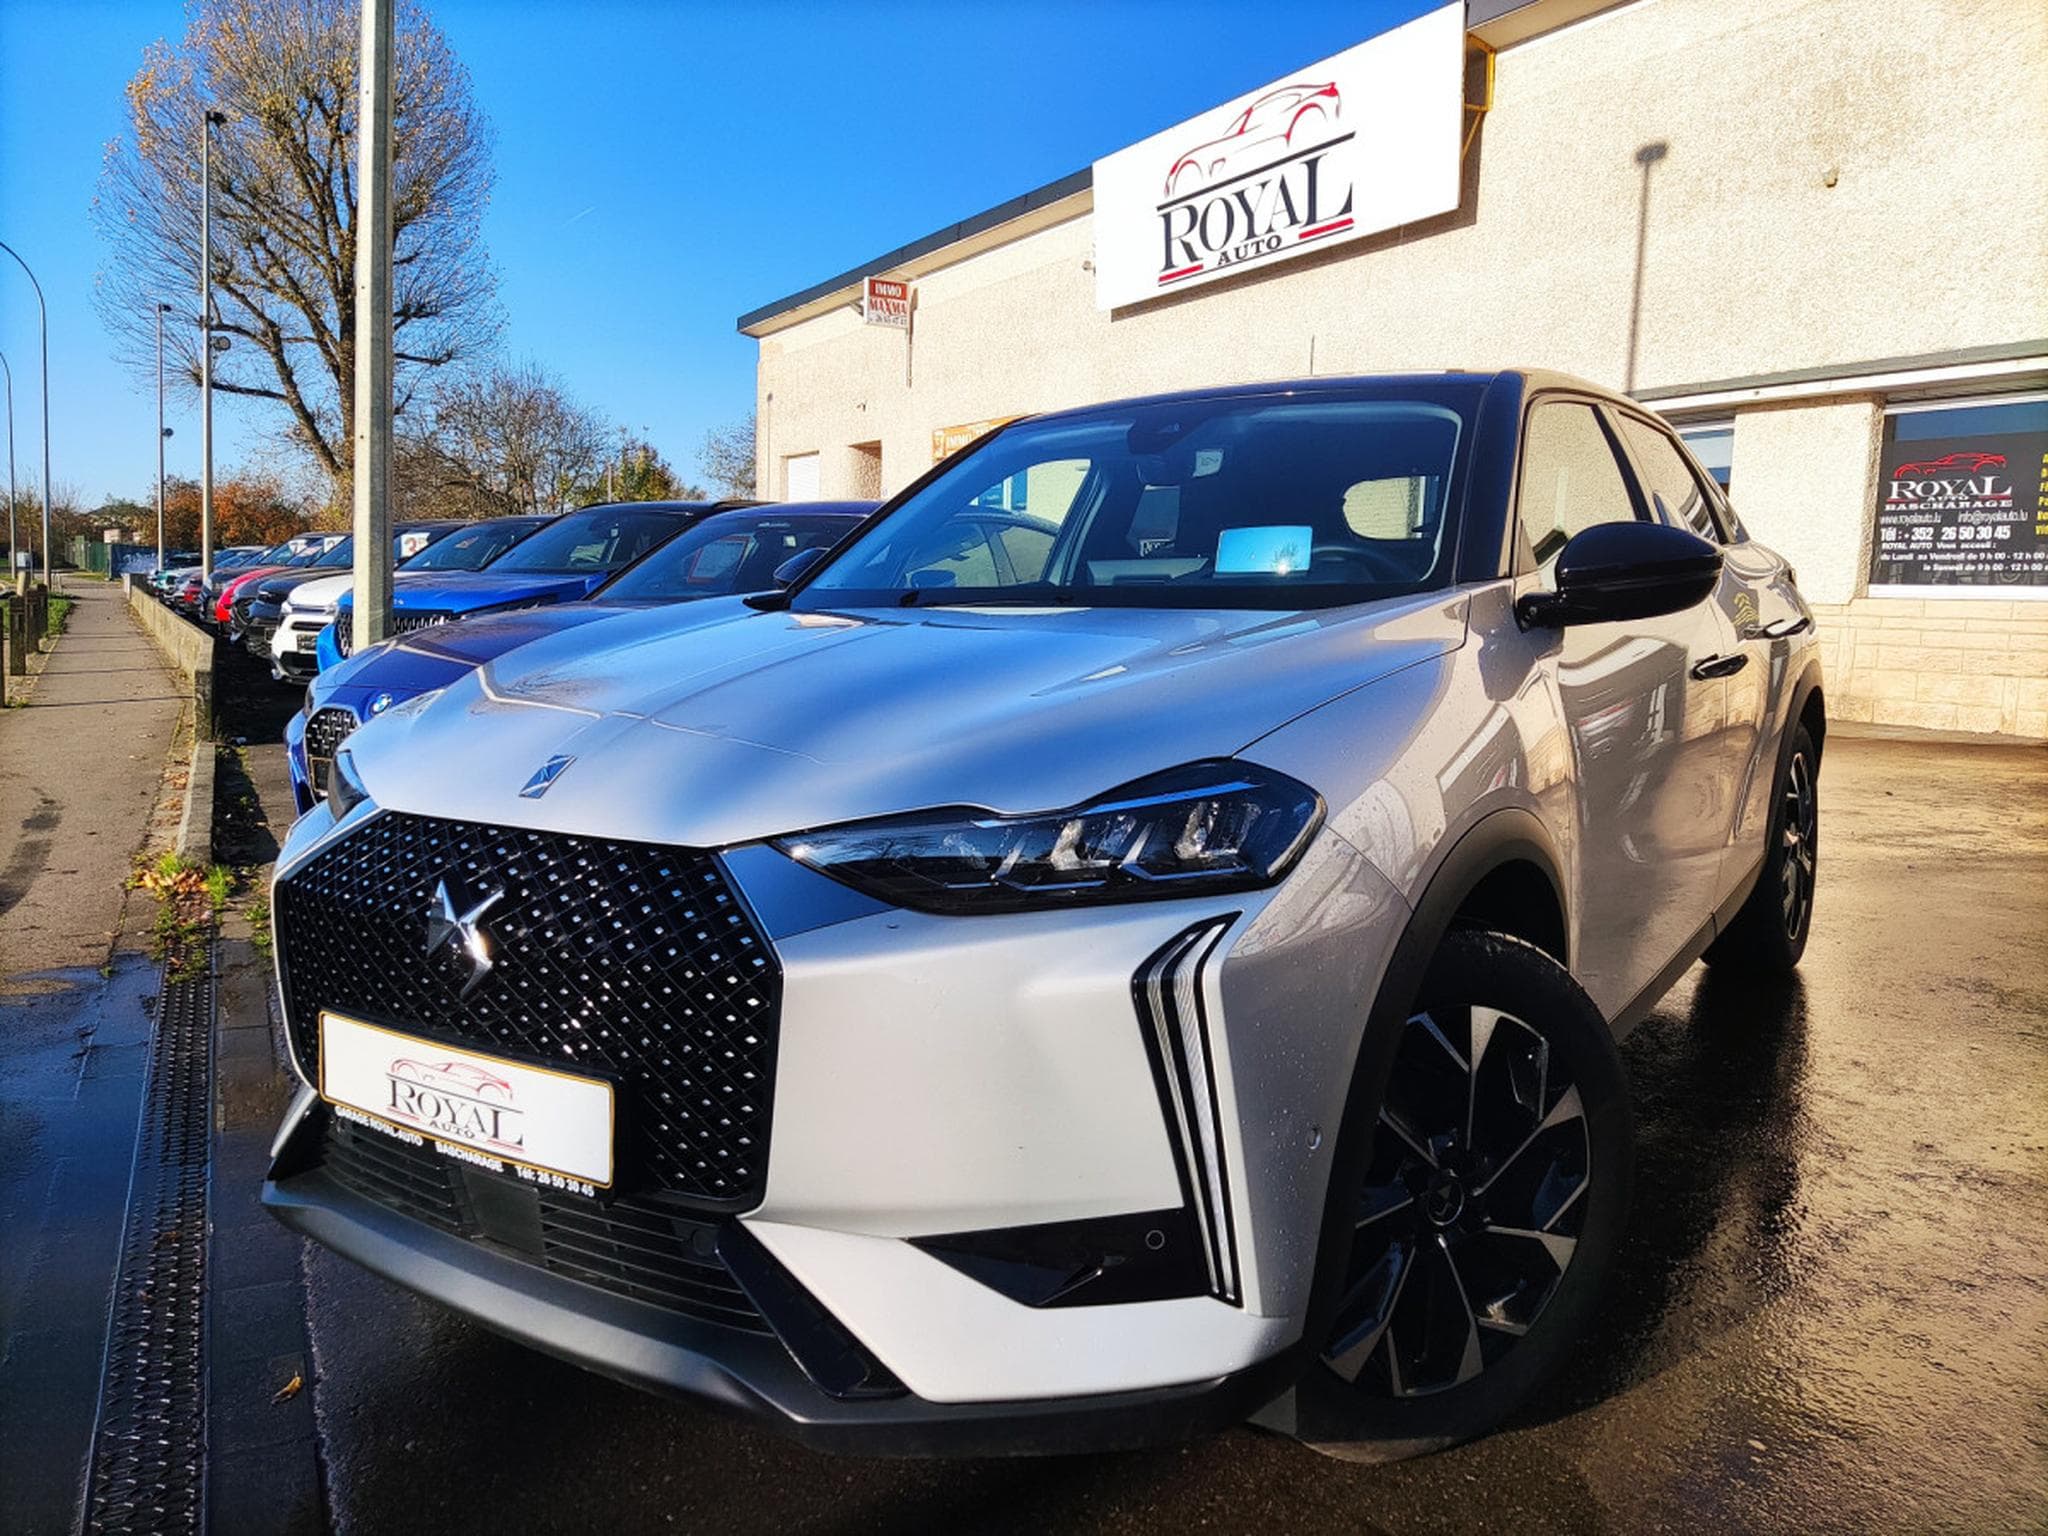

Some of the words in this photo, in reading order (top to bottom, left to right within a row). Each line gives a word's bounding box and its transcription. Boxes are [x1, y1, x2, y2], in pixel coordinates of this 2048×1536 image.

[1158, 152, 1353, 271] ROYAL
[1217, 234, 1283, 266] AUTO
[874, 282, 902, 298] IMMO
[1889, 475, 2013, 500] ROYAL
[1885, 500, 2013, 511] BASCHARAGE
[1926, 494, 1970, 503] AUTO
[1911, 526, 1934, 541] 352
[1941, 526, 1957, 540] 26
[1958, 526, 1975, 540] 50
[1976, 525, 1992, 540] 30
[1994, 525, 2011, 540] 45
[1882, 542, 1908, 550] ROYAL
[1909, 542, 1933, 550] AUTO
[390, 1079, 524, 1147] ROYAL
[428, 1120, 476, 1140] AUTO
[581, 1182, 595, 1198] 45
